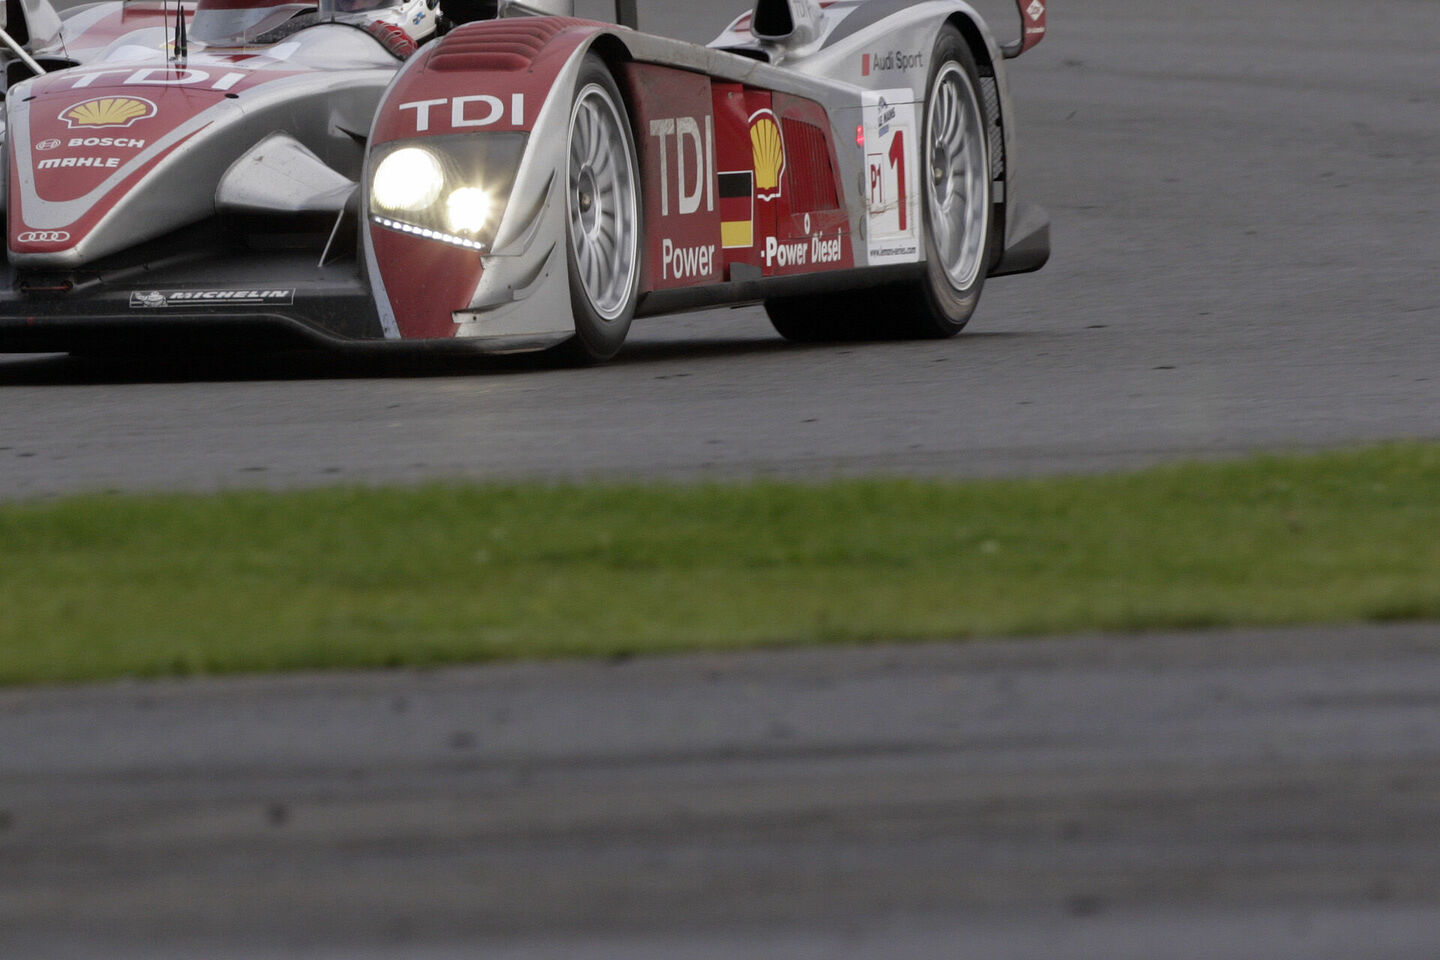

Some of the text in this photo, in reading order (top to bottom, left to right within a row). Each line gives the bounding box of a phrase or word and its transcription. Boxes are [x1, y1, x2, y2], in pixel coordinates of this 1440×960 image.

[60, 68, 247, 91] TDI
[872, 50, 924, 73] Audi Sport
[398, 93, 524, 132] TDI
[67, 137, 145, 148] BOSCH
[37, 156, 120, 169] MAHLE
[649, 114, 714, 216] TDI
[888, 129, 907, 231] 1
[869, 162, 883, 204] P1
[662, 239, 715, 280] Power
[811, 227, 842, 264] Diesel
[169, 290, 290, 300] MICHELIN
